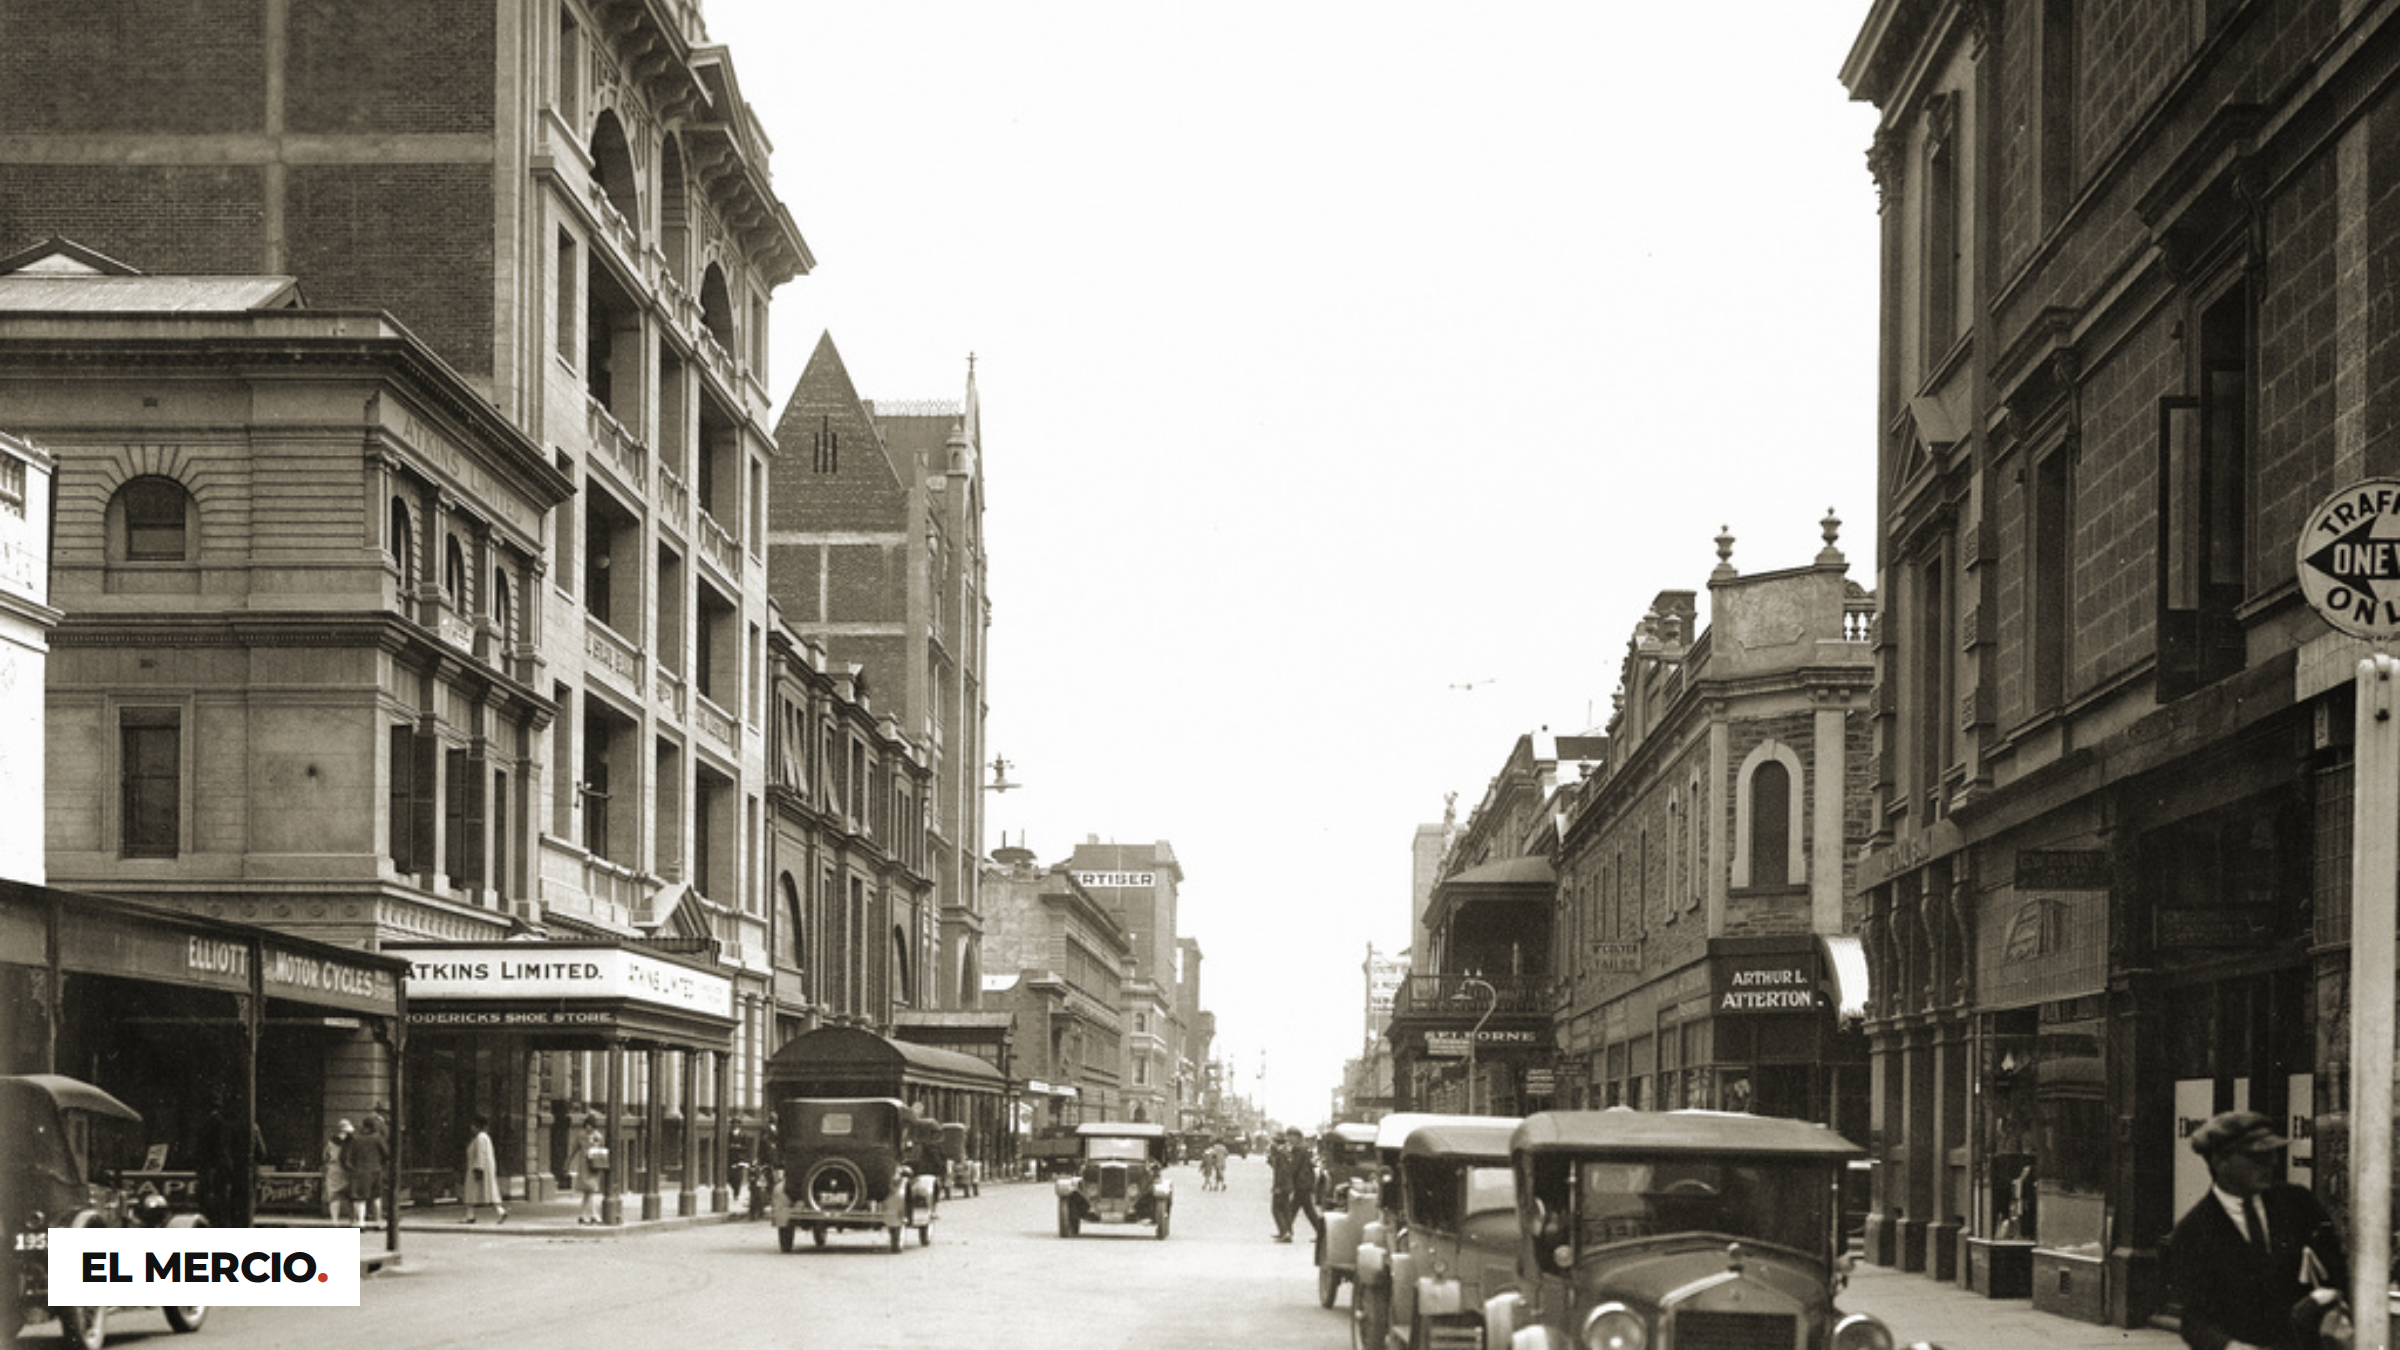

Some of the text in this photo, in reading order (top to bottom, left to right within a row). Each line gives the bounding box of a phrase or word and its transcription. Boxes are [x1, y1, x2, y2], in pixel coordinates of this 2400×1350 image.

[188, 935, 248, 974] ELLIOTT
[276, 950, 319, 988] MOTOR
[322, 961, 374, 997] CYCLES
[500, 961, 603, 980] LIMITED.
[1731, 969, 1793, 987] ARTHUR
[505, 1012, 548, 1024] SHOE
